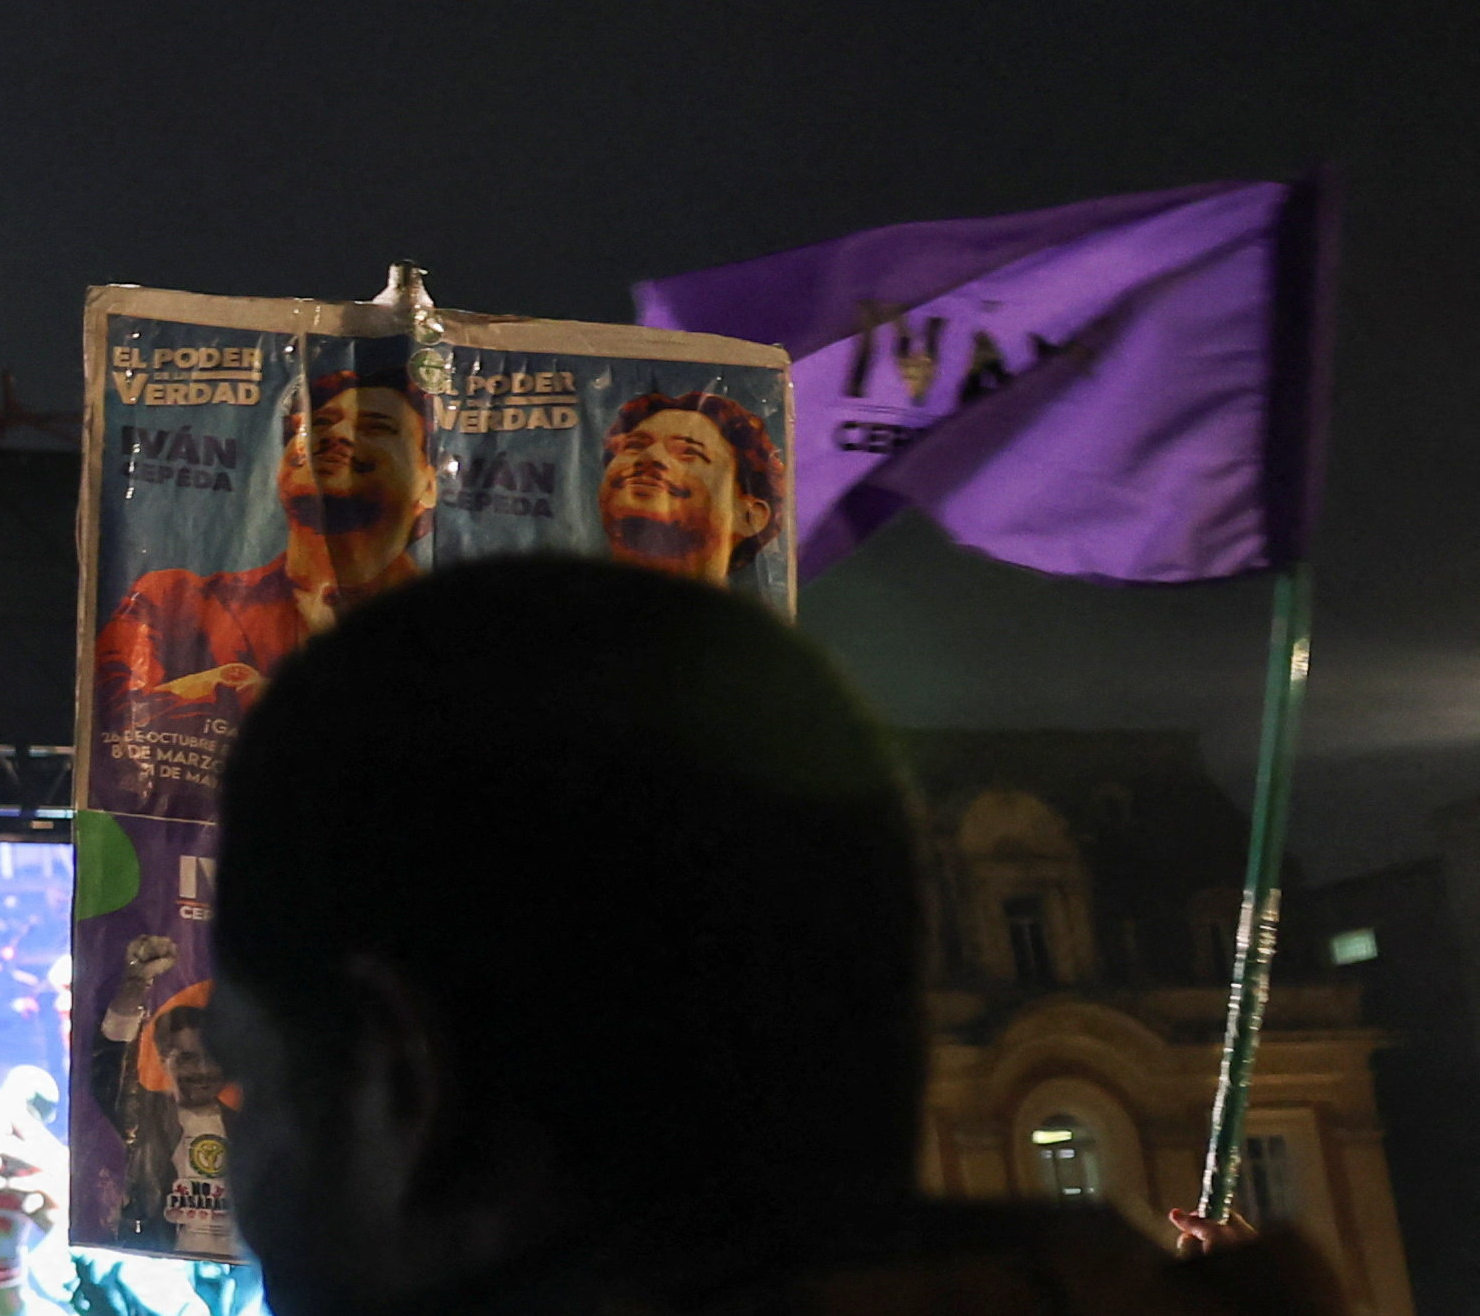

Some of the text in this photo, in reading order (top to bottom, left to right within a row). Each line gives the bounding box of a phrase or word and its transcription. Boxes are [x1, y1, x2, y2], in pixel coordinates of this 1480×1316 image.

[112, 346, 262, 371] EL PODER
[113, 371, 261, 406] VERDAD
[466, 371, 575, 394] PODER
